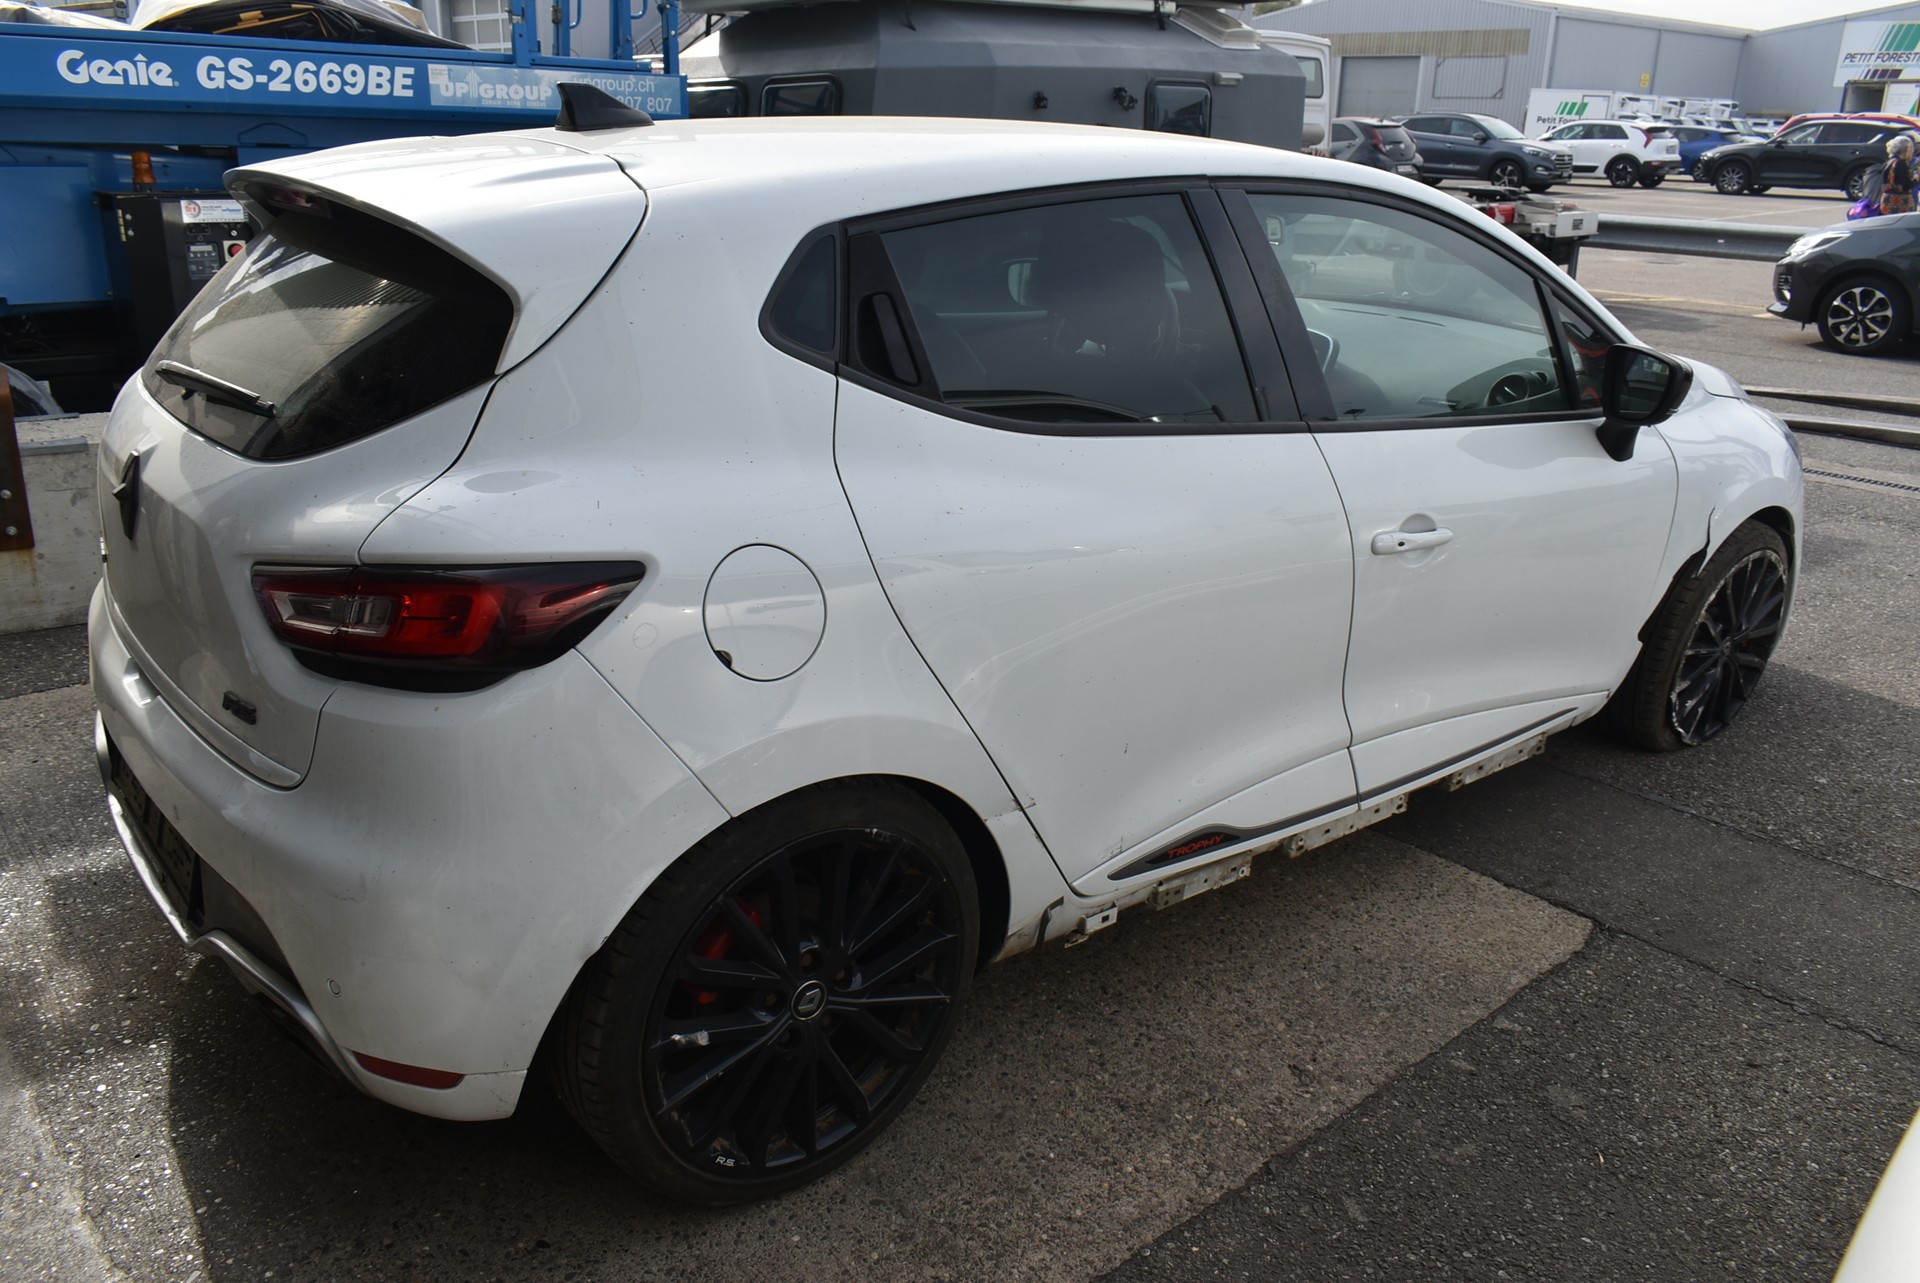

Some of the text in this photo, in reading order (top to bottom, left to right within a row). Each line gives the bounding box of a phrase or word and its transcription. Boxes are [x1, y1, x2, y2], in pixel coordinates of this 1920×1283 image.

[1842, 52, 1875, 63] PETIT
[57, 49, 415, 97] Genie GS-2669BE
[479, 83, 553, 101] GROUP
[646, 97, 673, 112] 807
[1536, 115, 1557, 124] Petit
[1167, 833, 1225, 859] TROPHY
